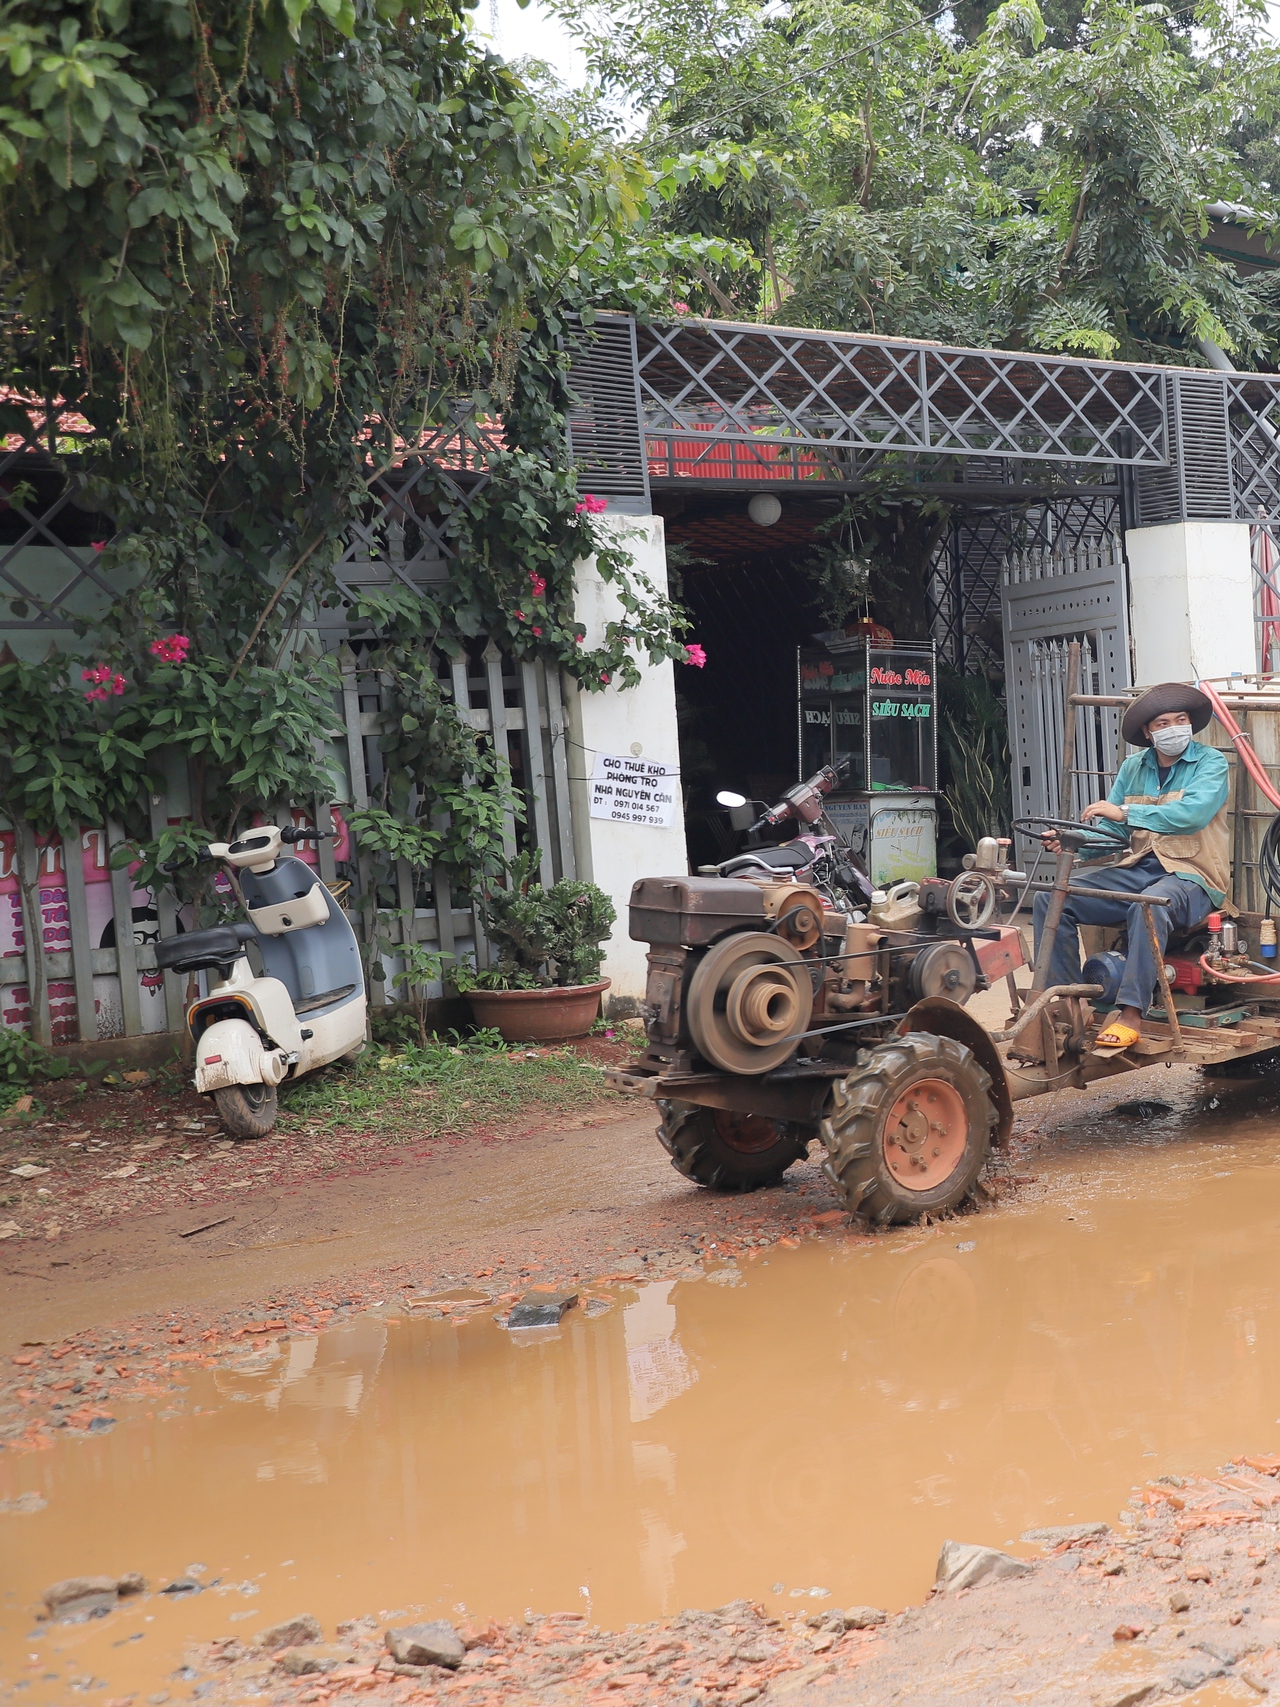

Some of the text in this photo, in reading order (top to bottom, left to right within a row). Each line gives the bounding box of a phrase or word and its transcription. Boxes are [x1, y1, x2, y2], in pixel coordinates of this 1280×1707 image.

[870, 667, 902, 685] Nước
[904, 668, 930, 685] Mía
[872, 699, 931, 720] SIÊU SẠCH
[603, 758, 666, 776] CHO THUÊ KHO
[606, 771, 658, 789] PHÒNG TRỌ
[595, 784, 672, 803] NHÀ NGUYÊN CĂN
[614, 800, 630, 808] 0971
[631, 802, 643, 810] 014
[646, 804, 660, 812] 567
[611, 811, 664, 824] 0945 997 939
